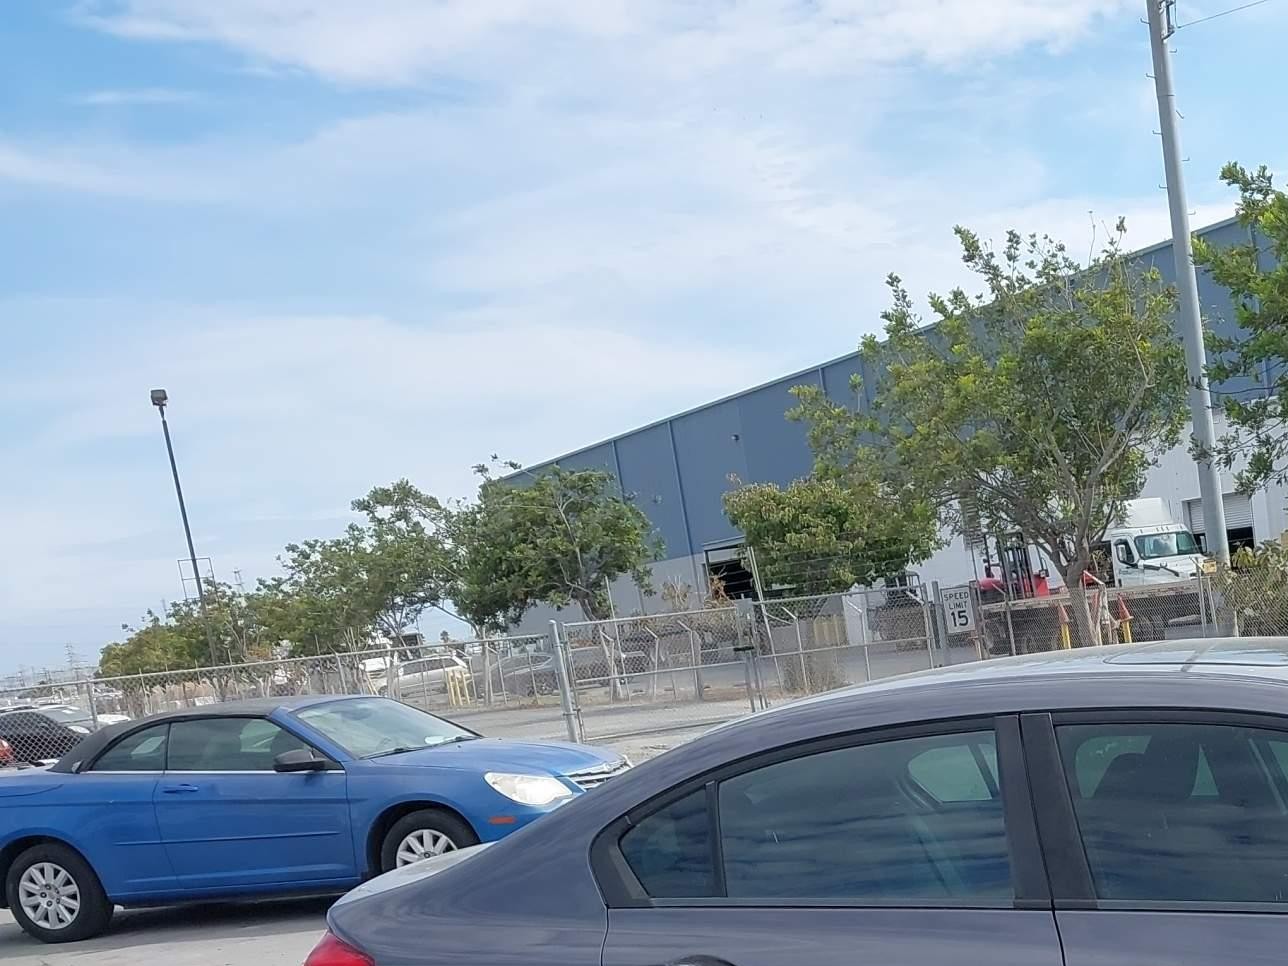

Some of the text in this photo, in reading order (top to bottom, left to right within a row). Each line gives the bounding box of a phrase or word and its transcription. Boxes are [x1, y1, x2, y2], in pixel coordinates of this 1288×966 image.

[944, 591, 969, 601] SPEED
[948, 600, 968, 610] LIMIT
[950, 610, 969, 627] 15
